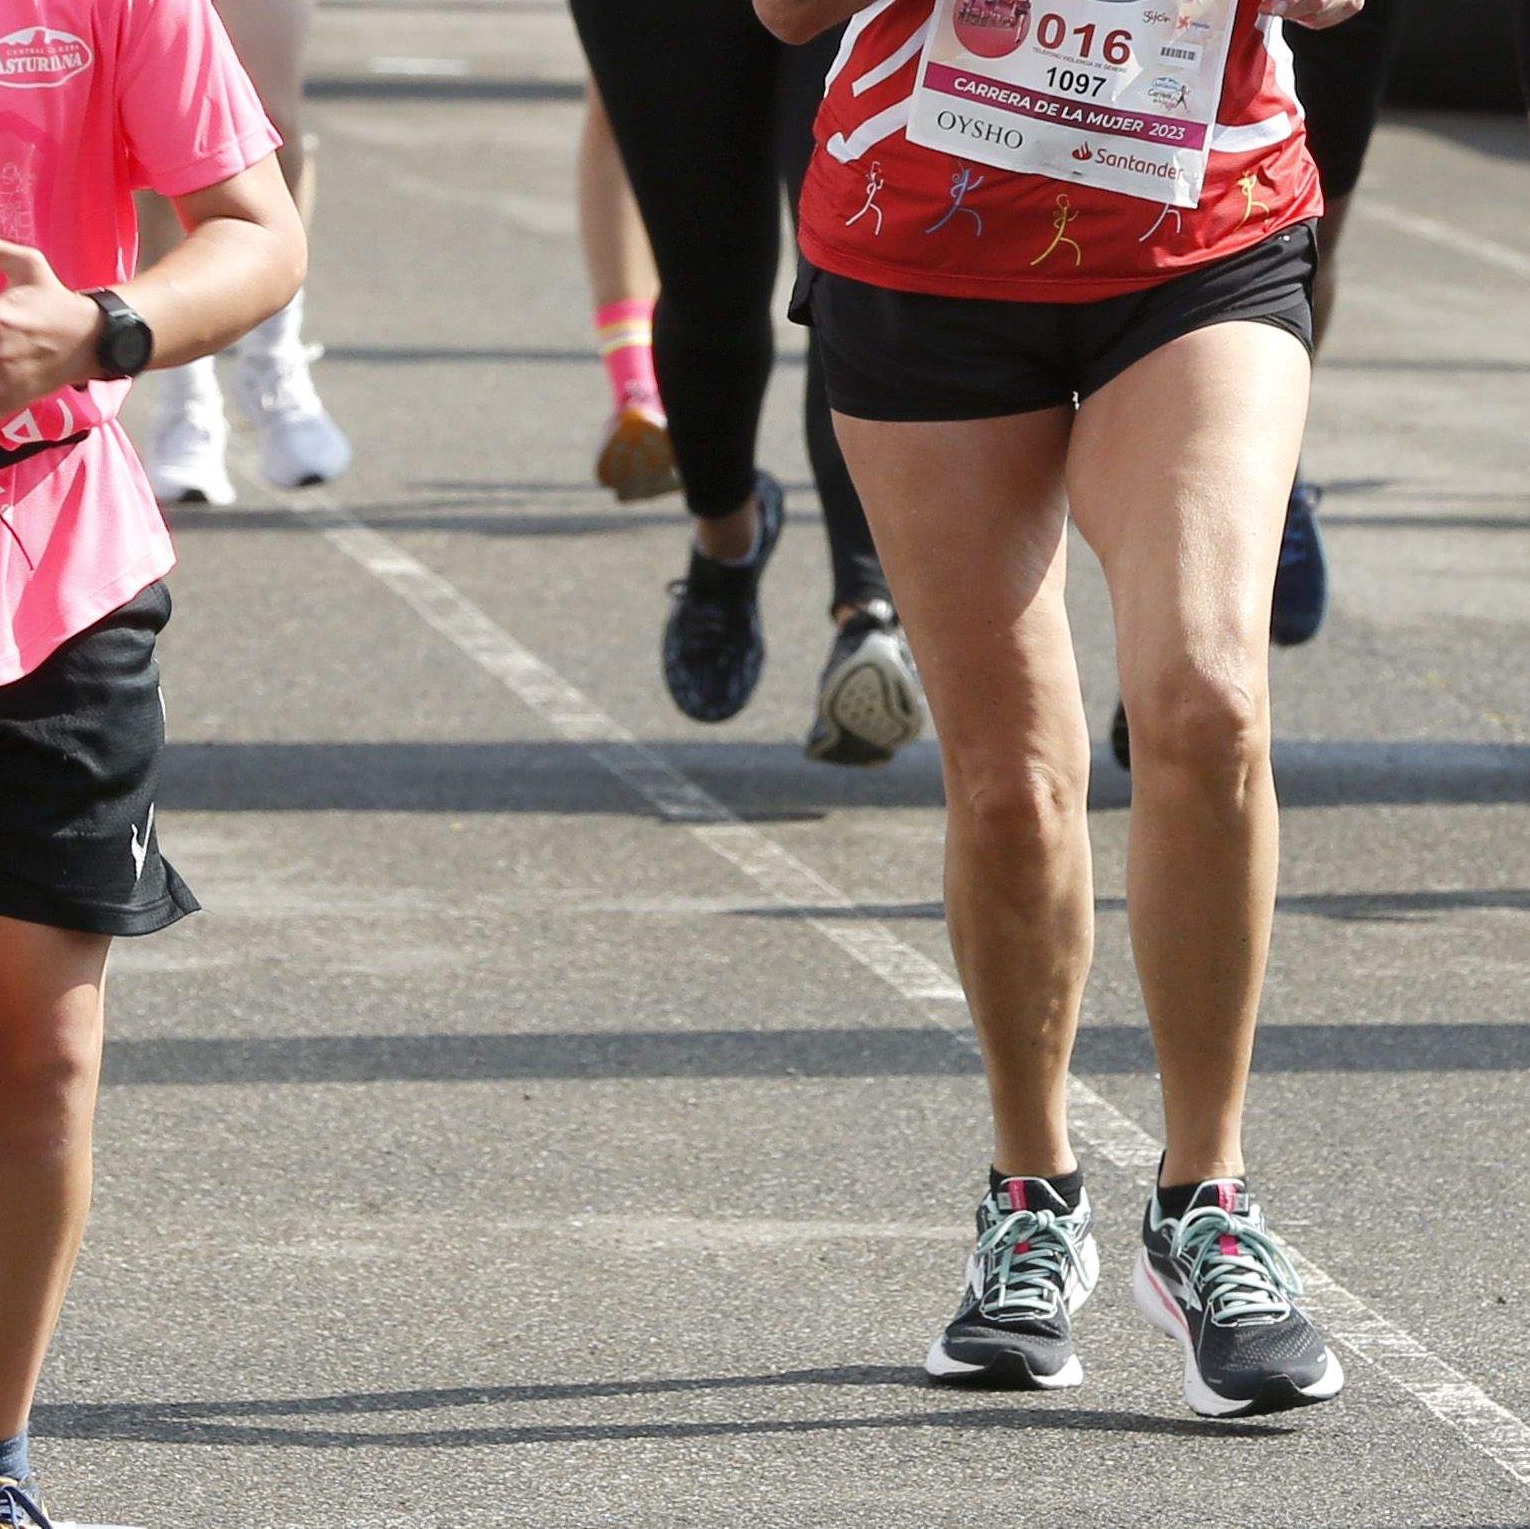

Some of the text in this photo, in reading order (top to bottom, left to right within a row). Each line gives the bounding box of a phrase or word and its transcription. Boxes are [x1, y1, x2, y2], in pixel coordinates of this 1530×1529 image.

[1036, 13, 1133, 65] 016
[1046, 66, 1107, 98] 1097
[953, 77, 1186, 141] CARRERA DE LA MUJER 2023
[937, 110, 1024, 150] OYSHO
[1095, 148, 1184, 180] Santander
